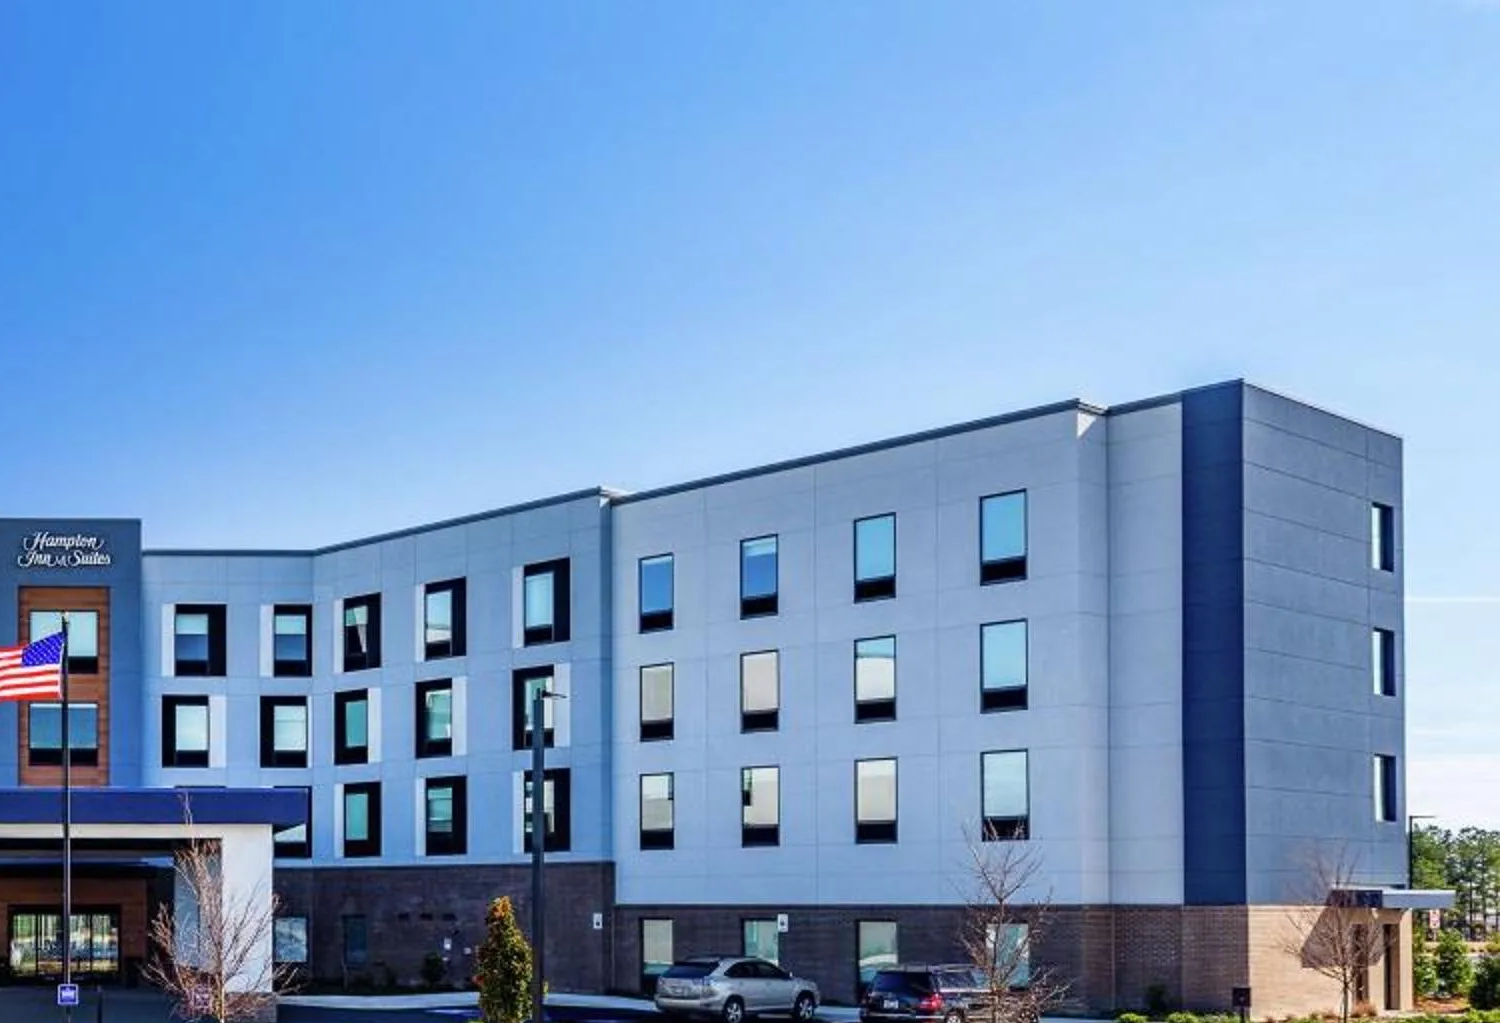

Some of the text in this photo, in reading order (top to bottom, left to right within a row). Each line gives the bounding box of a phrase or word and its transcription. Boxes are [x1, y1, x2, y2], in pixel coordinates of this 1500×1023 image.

[23, 532, 105, 551] Hampton
[17, 551, 56, 567] Inn
[68, 550, 111, 567] Suites
